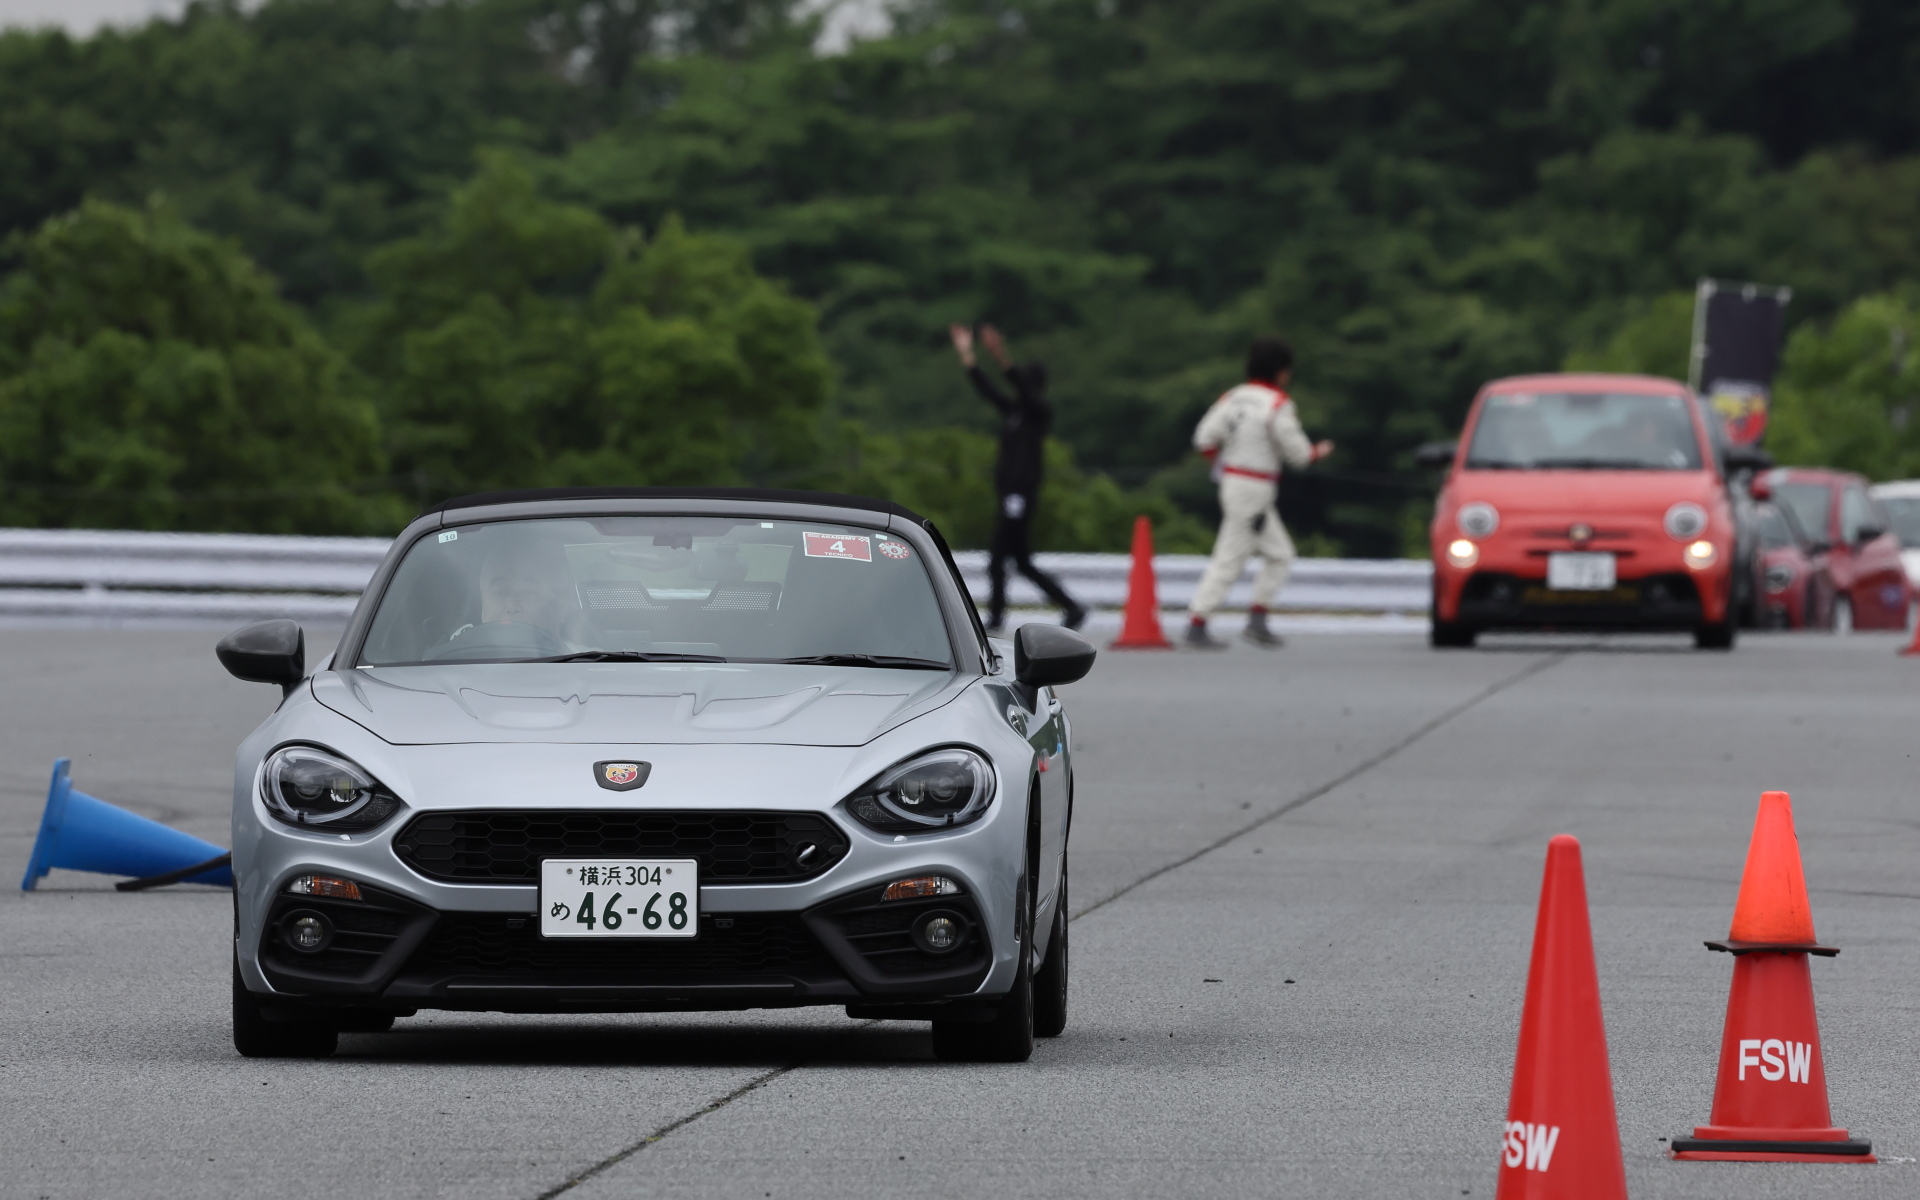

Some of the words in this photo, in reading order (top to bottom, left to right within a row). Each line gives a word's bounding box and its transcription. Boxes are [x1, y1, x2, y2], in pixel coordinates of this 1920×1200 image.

[829, 540, 846, 553] 4
[551, 901, 571, 921] め
[576, 891, 688, 931] 46-68
[1738, 1038, 1812, 1085] FSW
